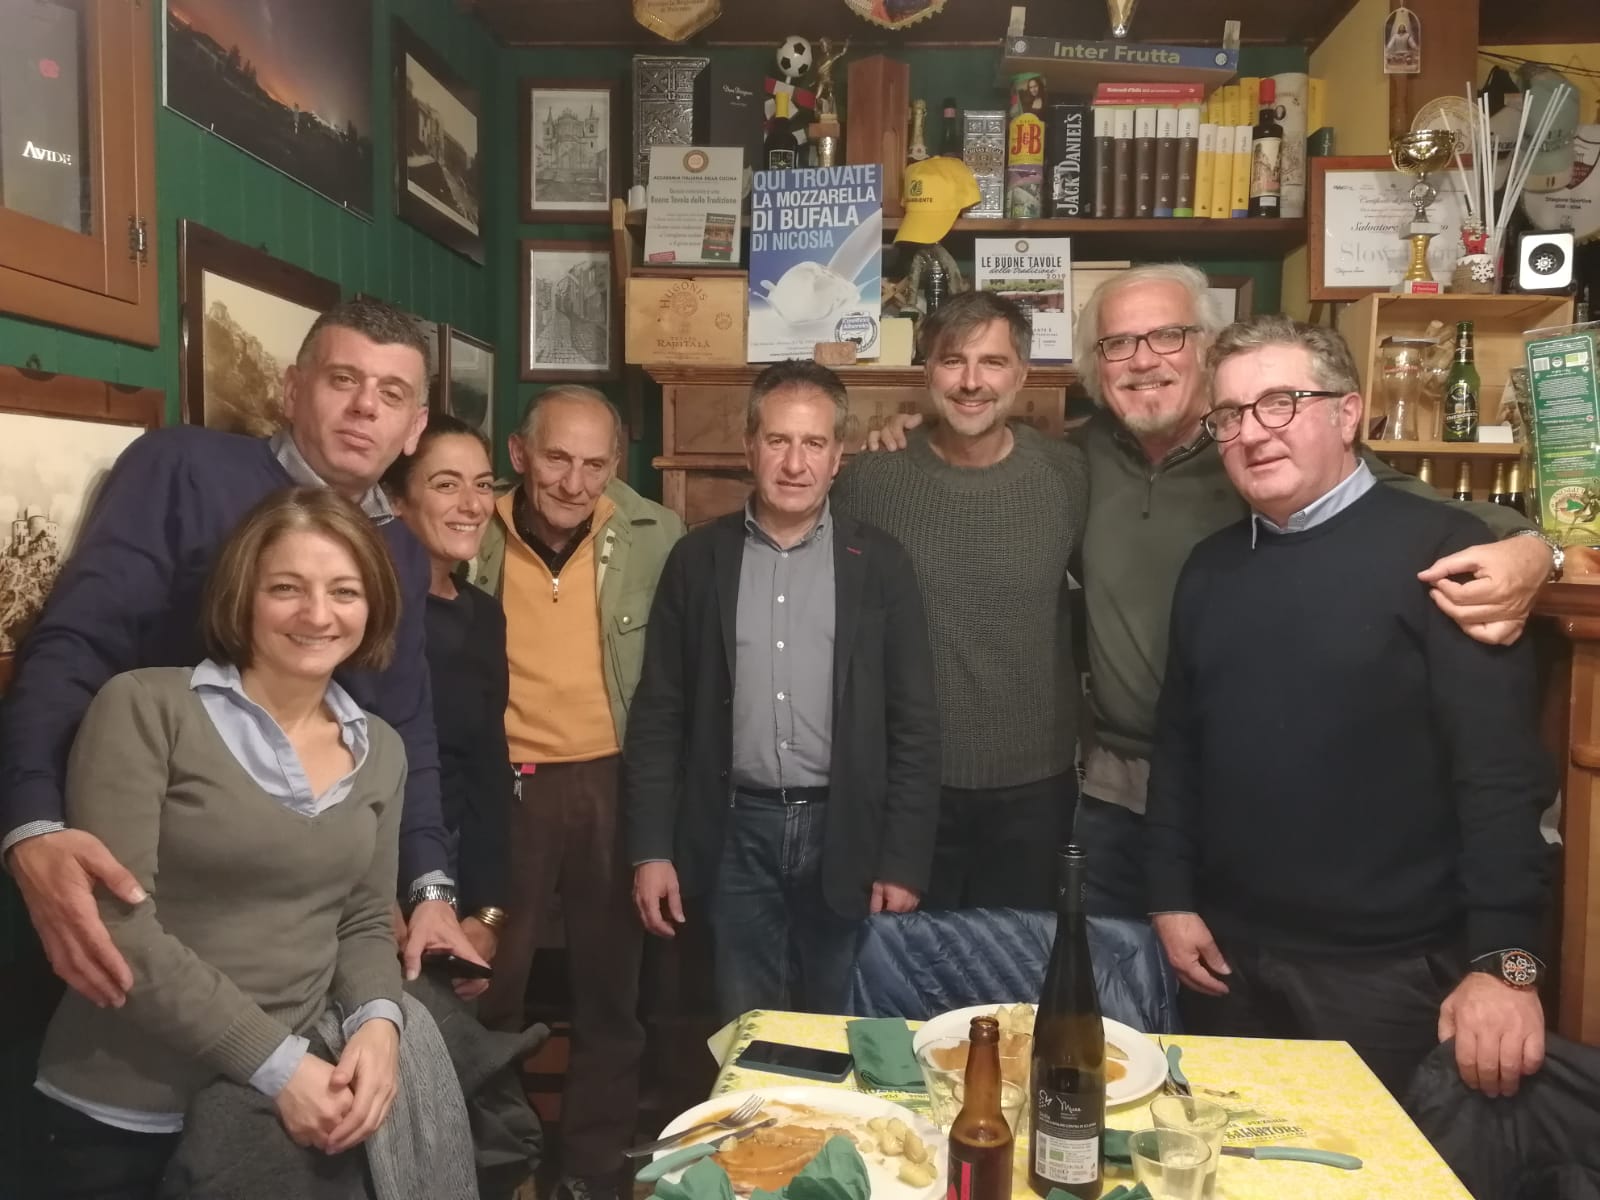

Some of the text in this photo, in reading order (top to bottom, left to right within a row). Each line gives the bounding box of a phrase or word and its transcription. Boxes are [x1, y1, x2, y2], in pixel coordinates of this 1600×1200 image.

[1054, 42, 1180, 64] Inter Frutta
[1011, 124, 1041, 155] J&B
[22, 141, 72, 165] AVIDE
[753, 164, 876, 191] QUI TROVATE
[753, 186, 876, 209] LA MOZZARELLA
[753, 205, 859, 231] DI BUFALA
[752, 230, 834, 252] DI NICOSIA
[981, 256, 1063, 268] LE BUONE TAVOLE
